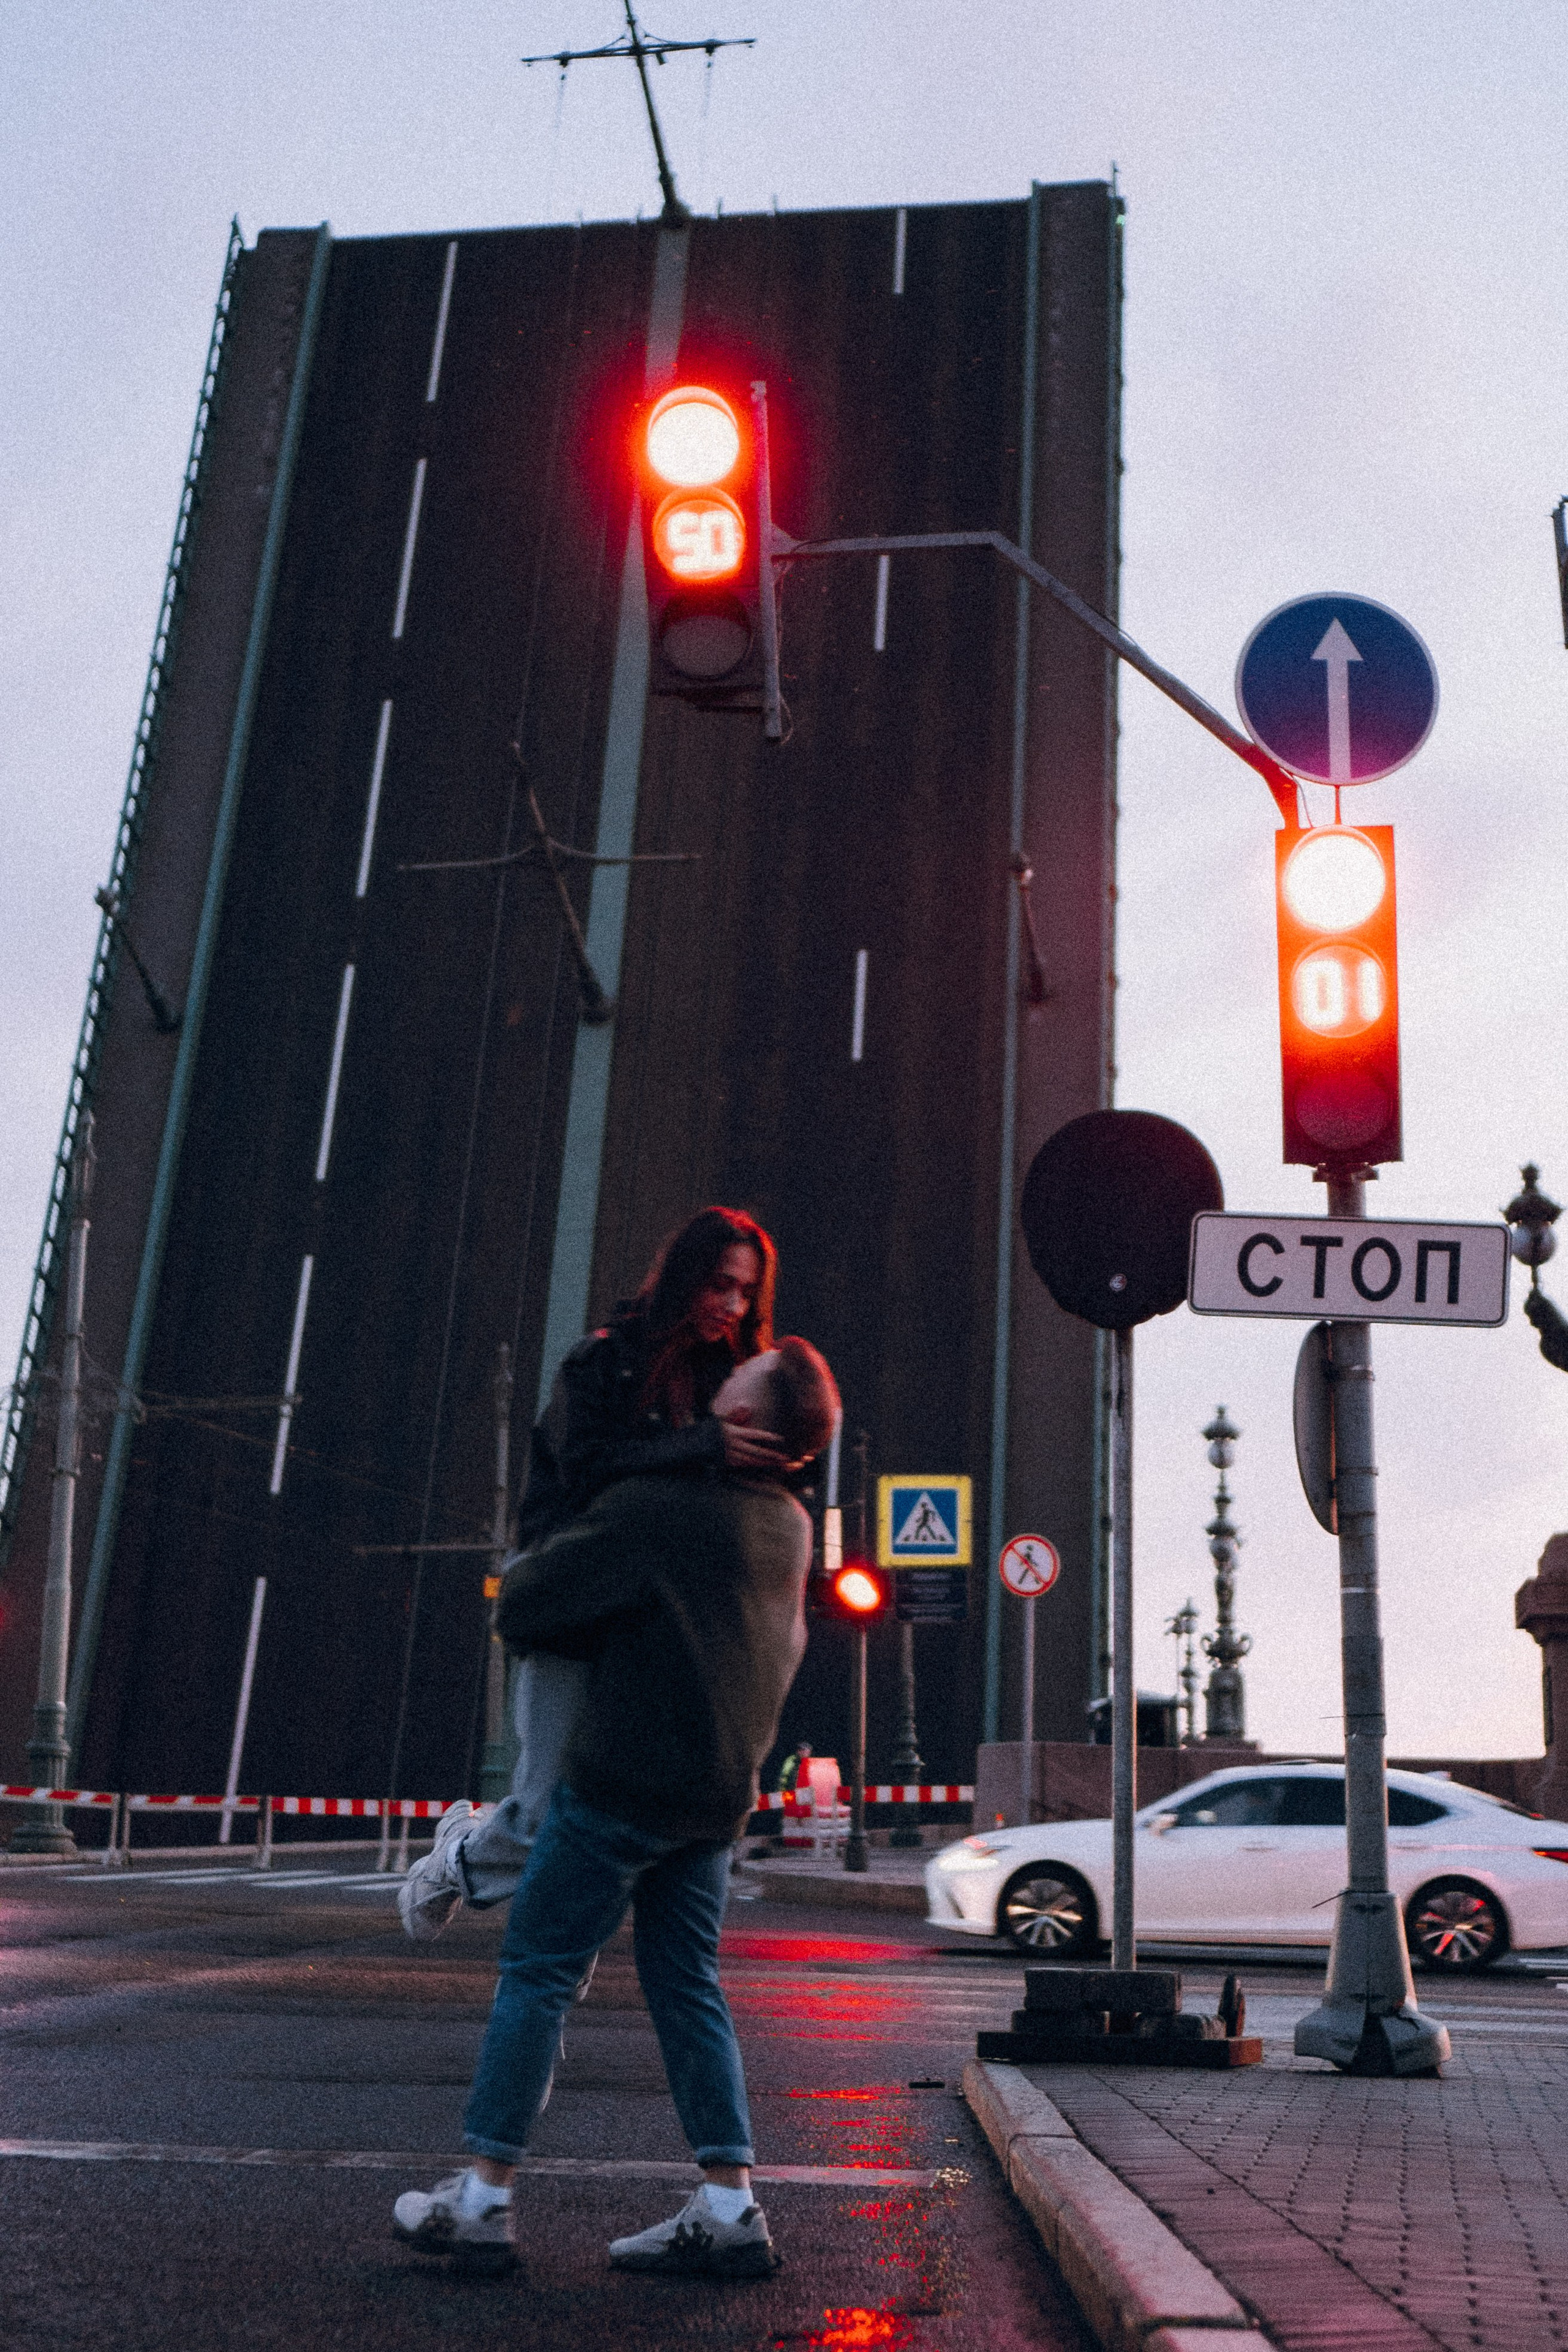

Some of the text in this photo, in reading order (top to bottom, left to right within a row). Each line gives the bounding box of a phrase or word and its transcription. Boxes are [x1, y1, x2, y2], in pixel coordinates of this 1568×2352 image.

[668, 511, 737, 572] 50
[1301, 959, 1379, 1027] 01
[1237, 1232, 1461, 1305] СТОП
